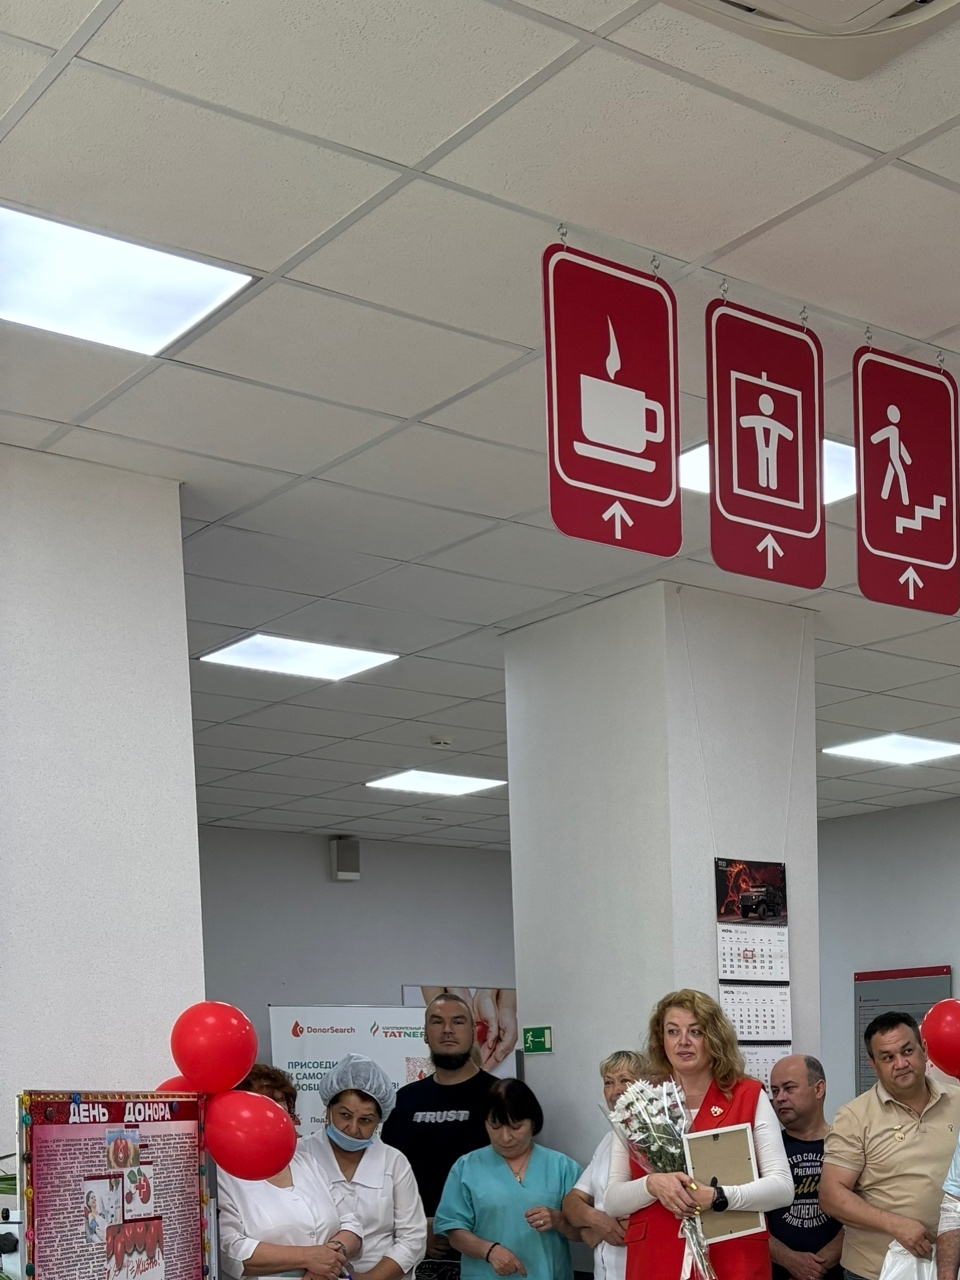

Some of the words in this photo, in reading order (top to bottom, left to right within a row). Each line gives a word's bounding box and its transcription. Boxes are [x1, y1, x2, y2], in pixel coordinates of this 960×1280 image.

[306, 1026, 356, 1034] DonorSearch
[287, 1061, 338, 1070] ПРИСОЕДИ
[69, 1103, 109, 1124] ДЕНЬ
[124, 1103, 171, 1123] ДОНОРА
[413, 1110, 469, 1123] TRUST
[788, 1154, 802, 1164] TED
[803, 1153, 824, 1161] COLLE
[782, 1212, 802, 1228] PRIME
[803, 1214, 831, 1228] QUALIT
